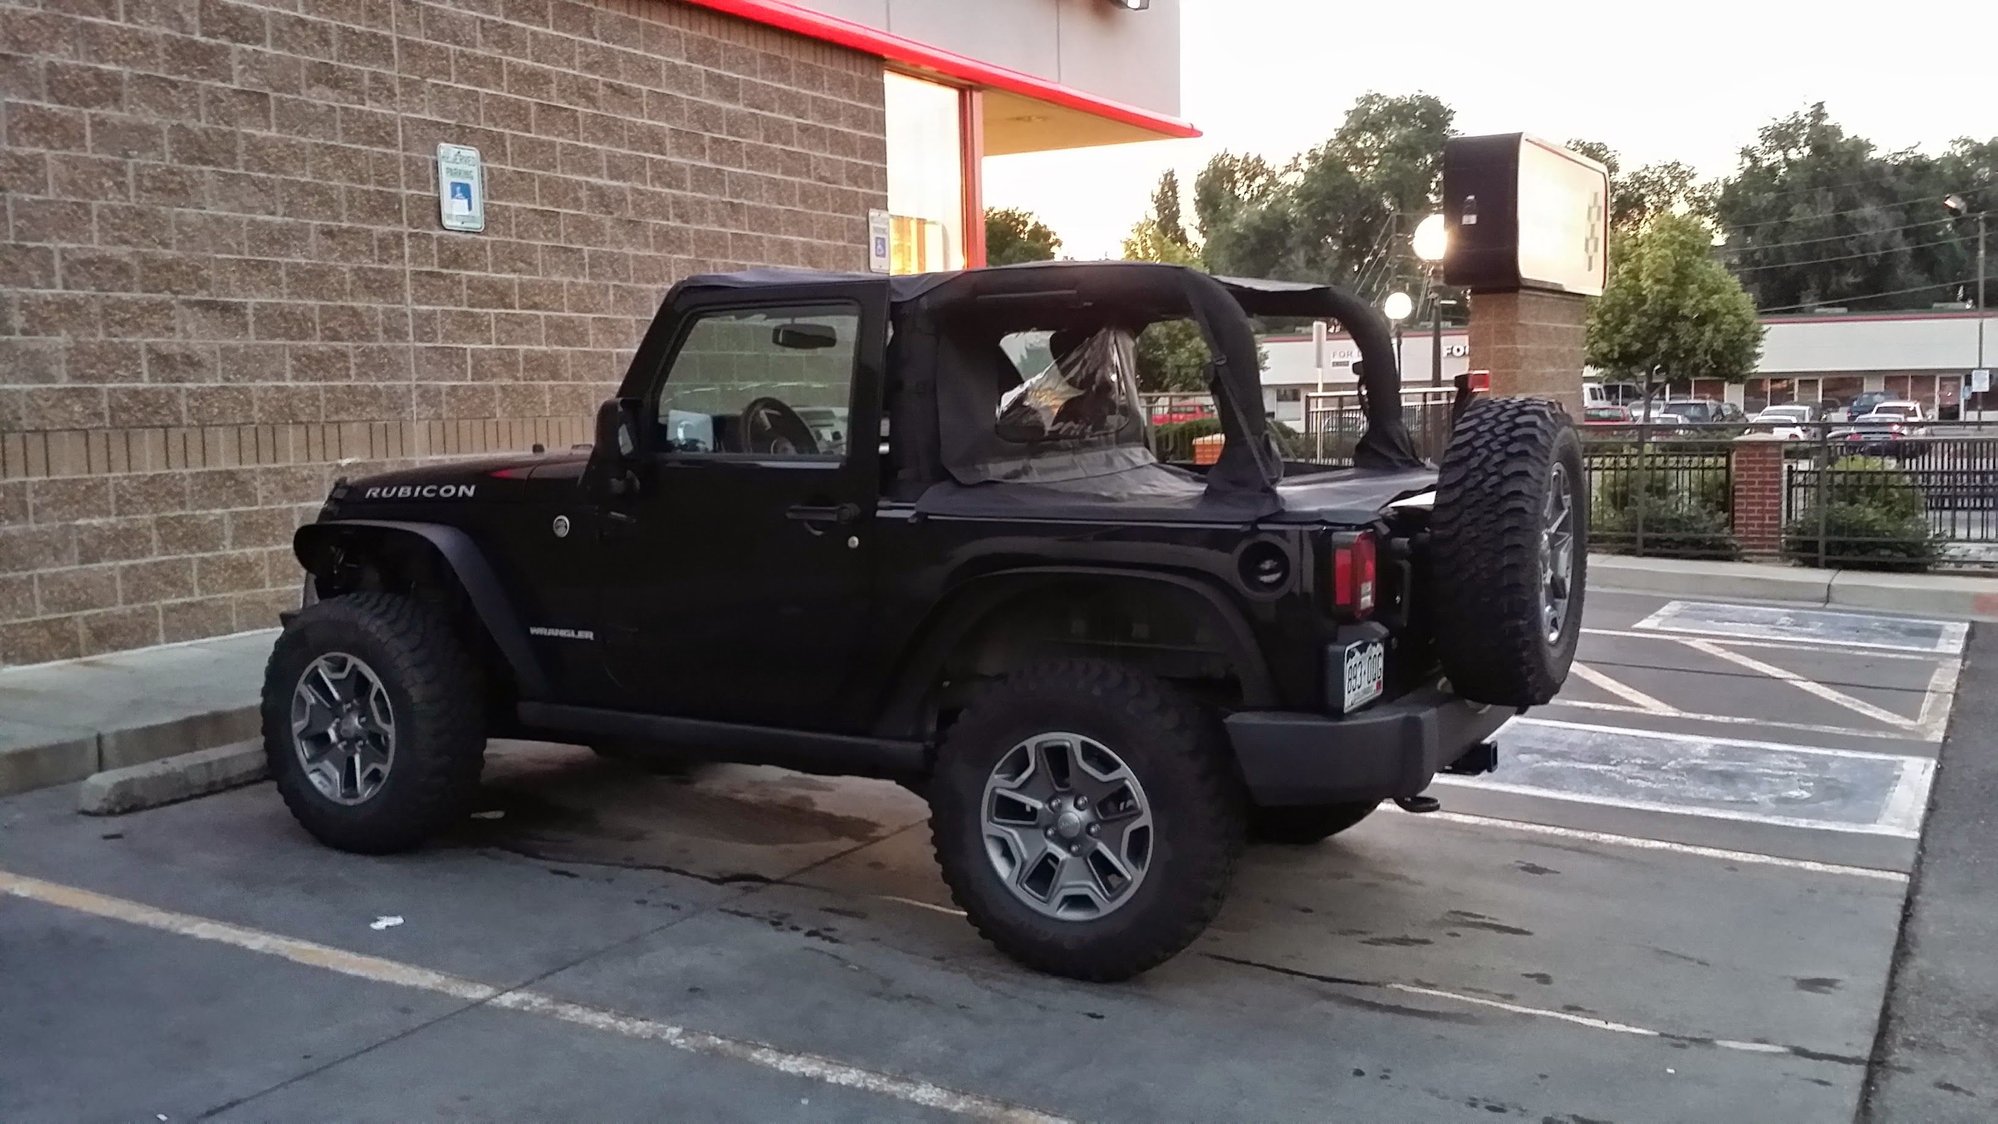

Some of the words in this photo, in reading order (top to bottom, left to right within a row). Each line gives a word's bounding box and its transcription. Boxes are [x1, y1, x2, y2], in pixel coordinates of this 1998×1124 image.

[445, 167, 474, 180] PARKING
[365, 484, 476, 498] RUBICON
[530, 626, 594, 640] WRANGLER
